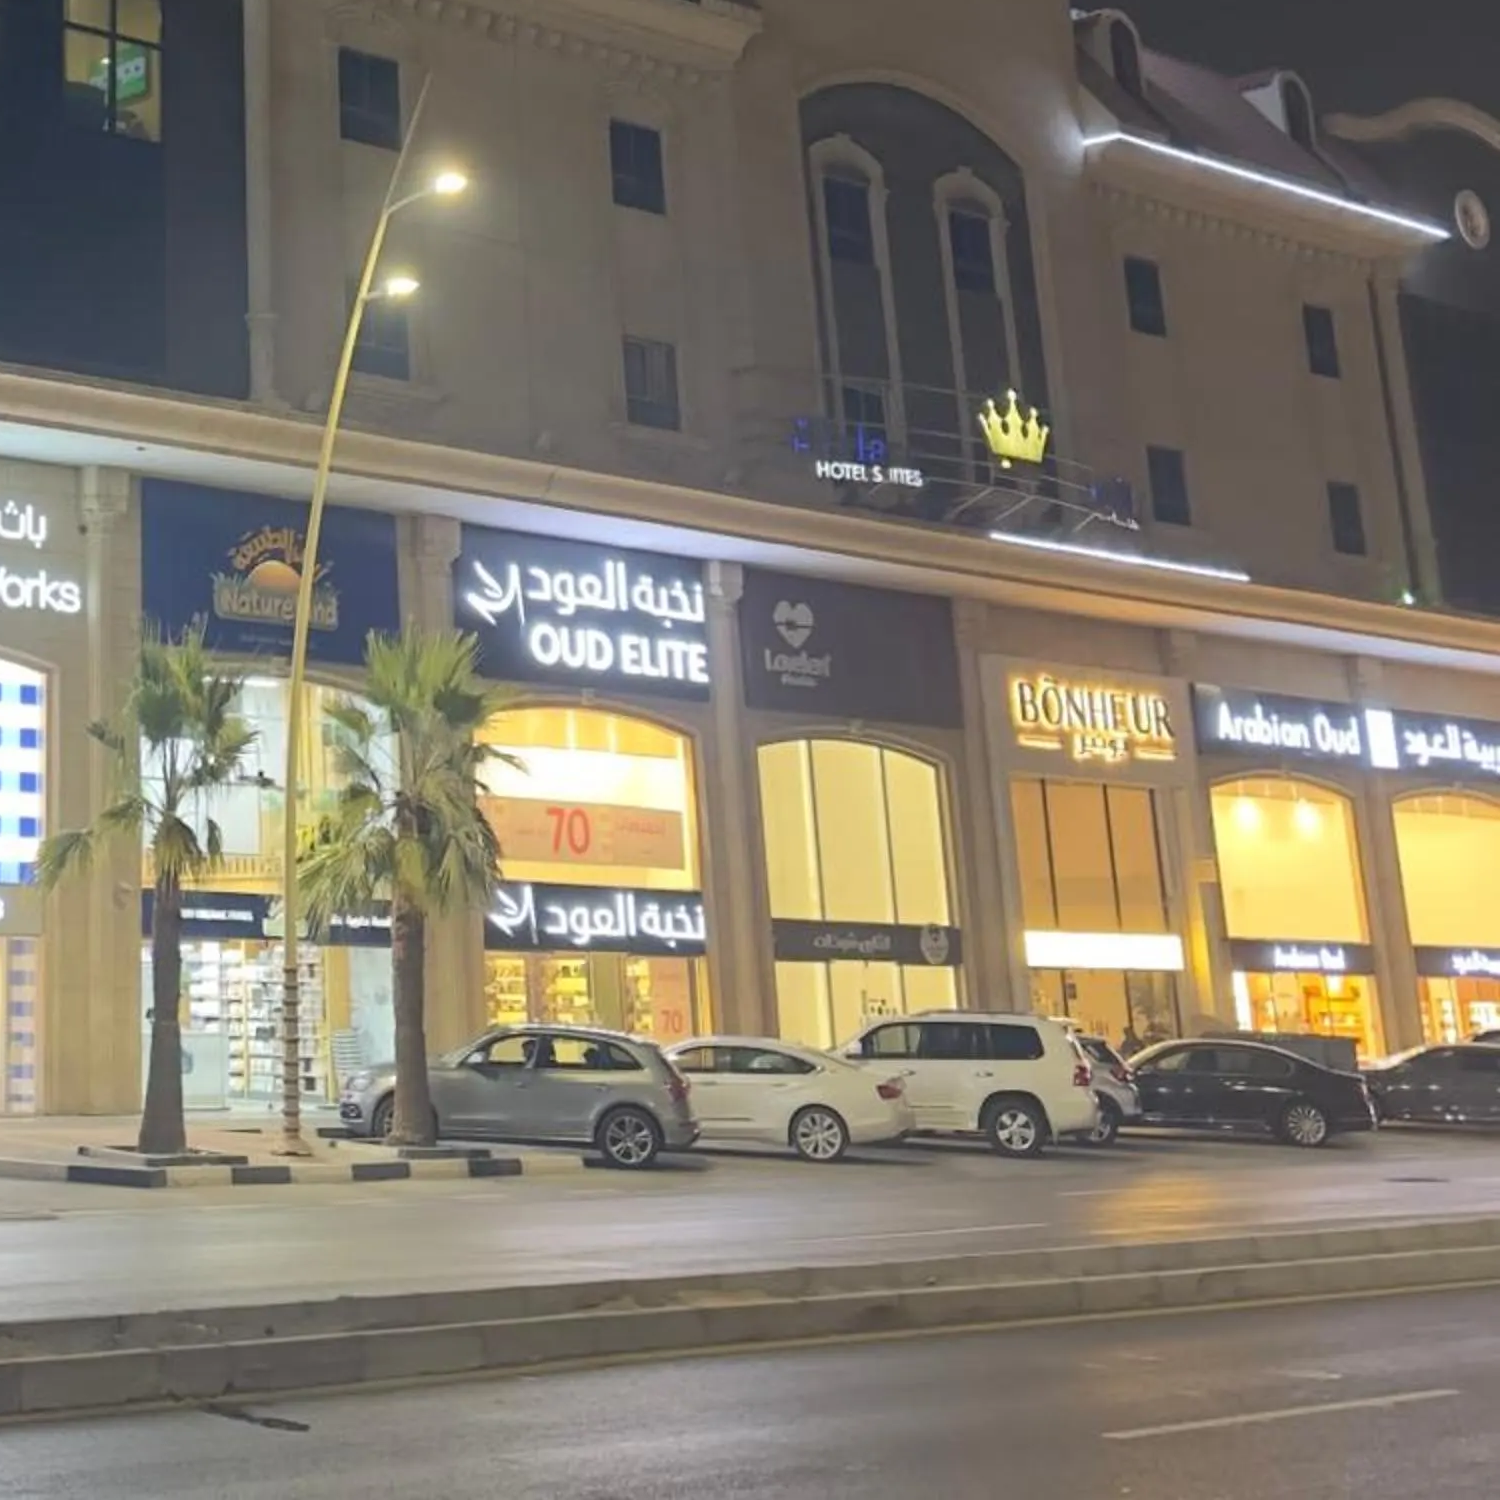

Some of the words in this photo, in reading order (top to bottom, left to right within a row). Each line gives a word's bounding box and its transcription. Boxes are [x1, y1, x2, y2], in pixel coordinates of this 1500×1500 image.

[815, 460, 868, 482] HOTEL
[871, 465, 924, 488] SITES
[526, 559, 629, 617] العود
[631, 574, 706, 629] نخبة
[529, 621, 615, 672] OUD
[620, 633, 711, 684] ELITE
[1218, 701, 1311, 749] Arabian
[1313, 711, 1362, 756] Oud
[544, 806, 591, 856] 70
[543, 891, 638, 947] العود
[639, 902, 706, 948] نخبة
[660, 1008, 684, 1034] 70
